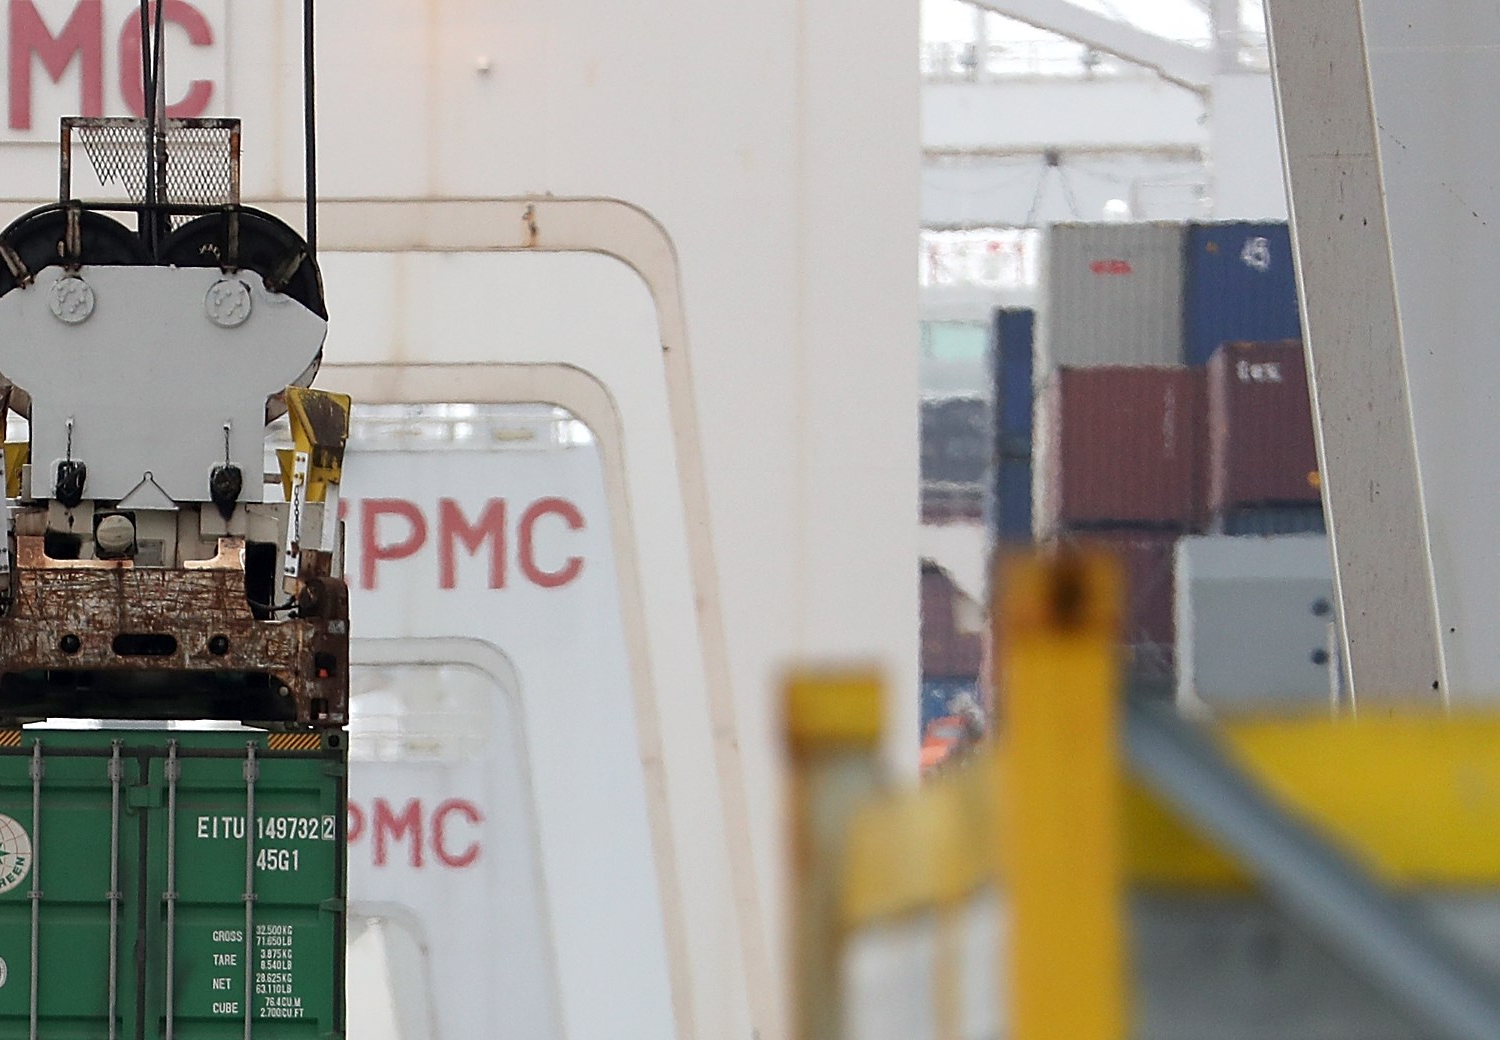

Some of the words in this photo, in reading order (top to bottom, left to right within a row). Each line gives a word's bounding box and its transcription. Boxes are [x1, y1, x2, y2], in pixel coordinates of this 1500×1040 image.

[338, 496, 587, 591] PMC
[197, 816, 245, 839] EITU
[256, 849, 299, 871] 45G1
[212, 930, 243, 942] GROSS
[213, 954, 237, 966] TARE
[212, 978, 231, 990] NET
[212, 1002, 238, 1014] CUBE
